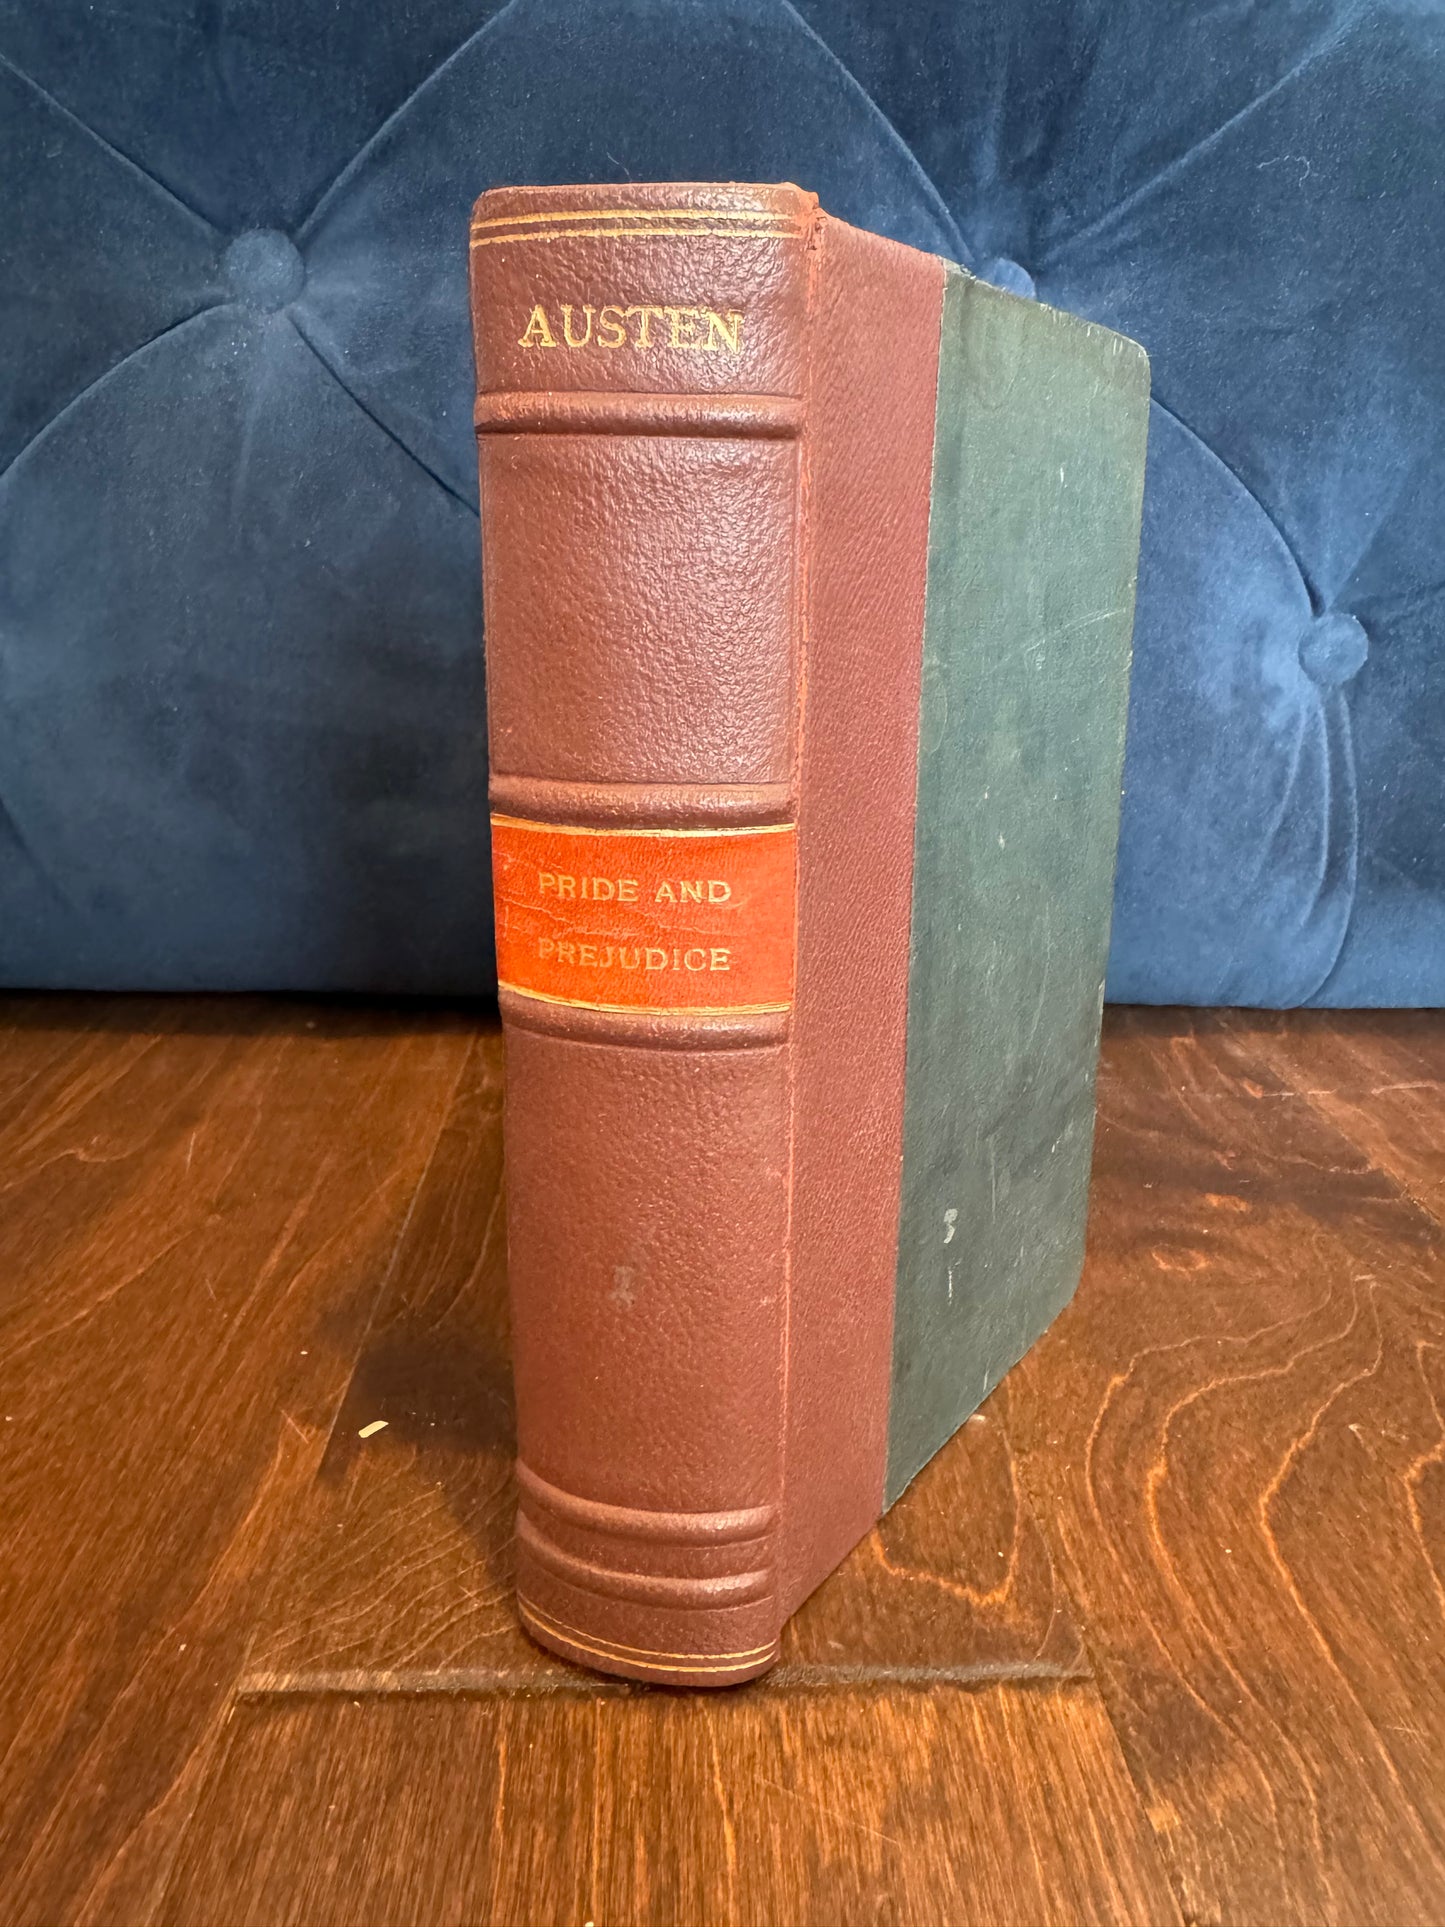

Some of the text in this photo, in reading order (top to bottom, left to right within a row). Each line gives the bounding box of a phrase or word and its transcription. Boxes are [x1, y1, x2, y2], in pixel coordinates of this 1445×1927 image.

[517, 303, 745, 353] AUSTEN
[538, 871, 732, 903] PRIDE AND
[538, 937, 732, 972] PREJUDICE
